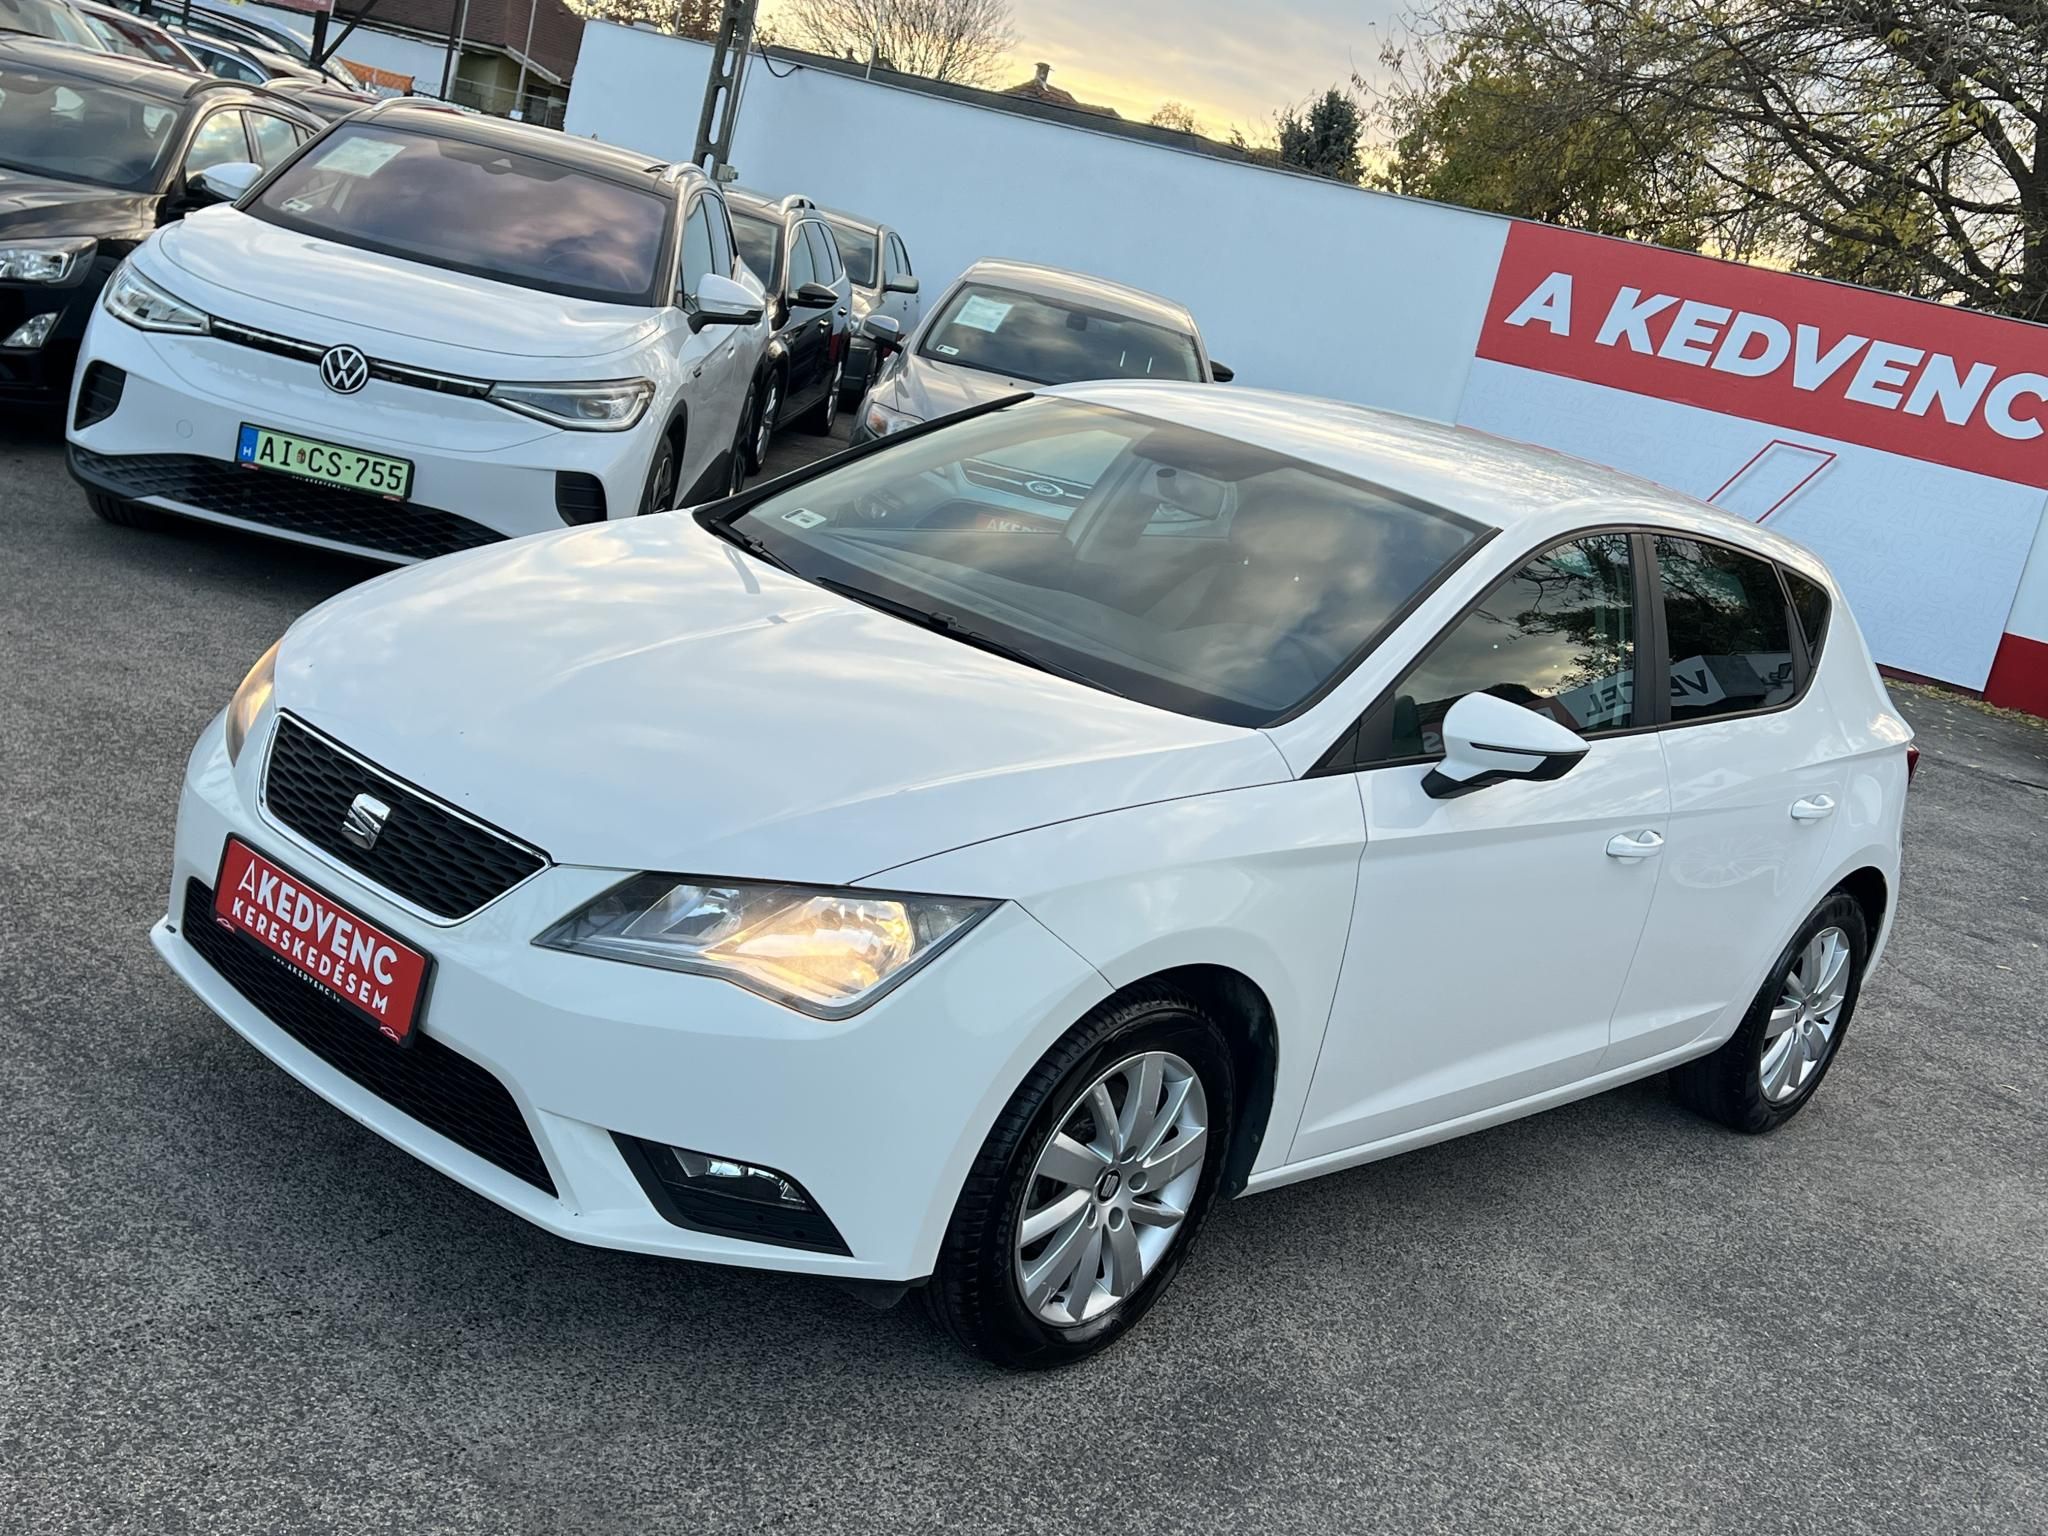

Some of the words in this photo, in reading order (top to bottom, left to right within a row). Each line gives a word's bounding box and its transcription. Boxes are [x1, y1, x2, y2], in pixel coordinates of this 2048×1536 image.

[1504, 272, 1573, 336] A
[1594, 286, 2048, 439] KEDVENC
[231, 896, 389, 1015] KERESKEDÉSEM
